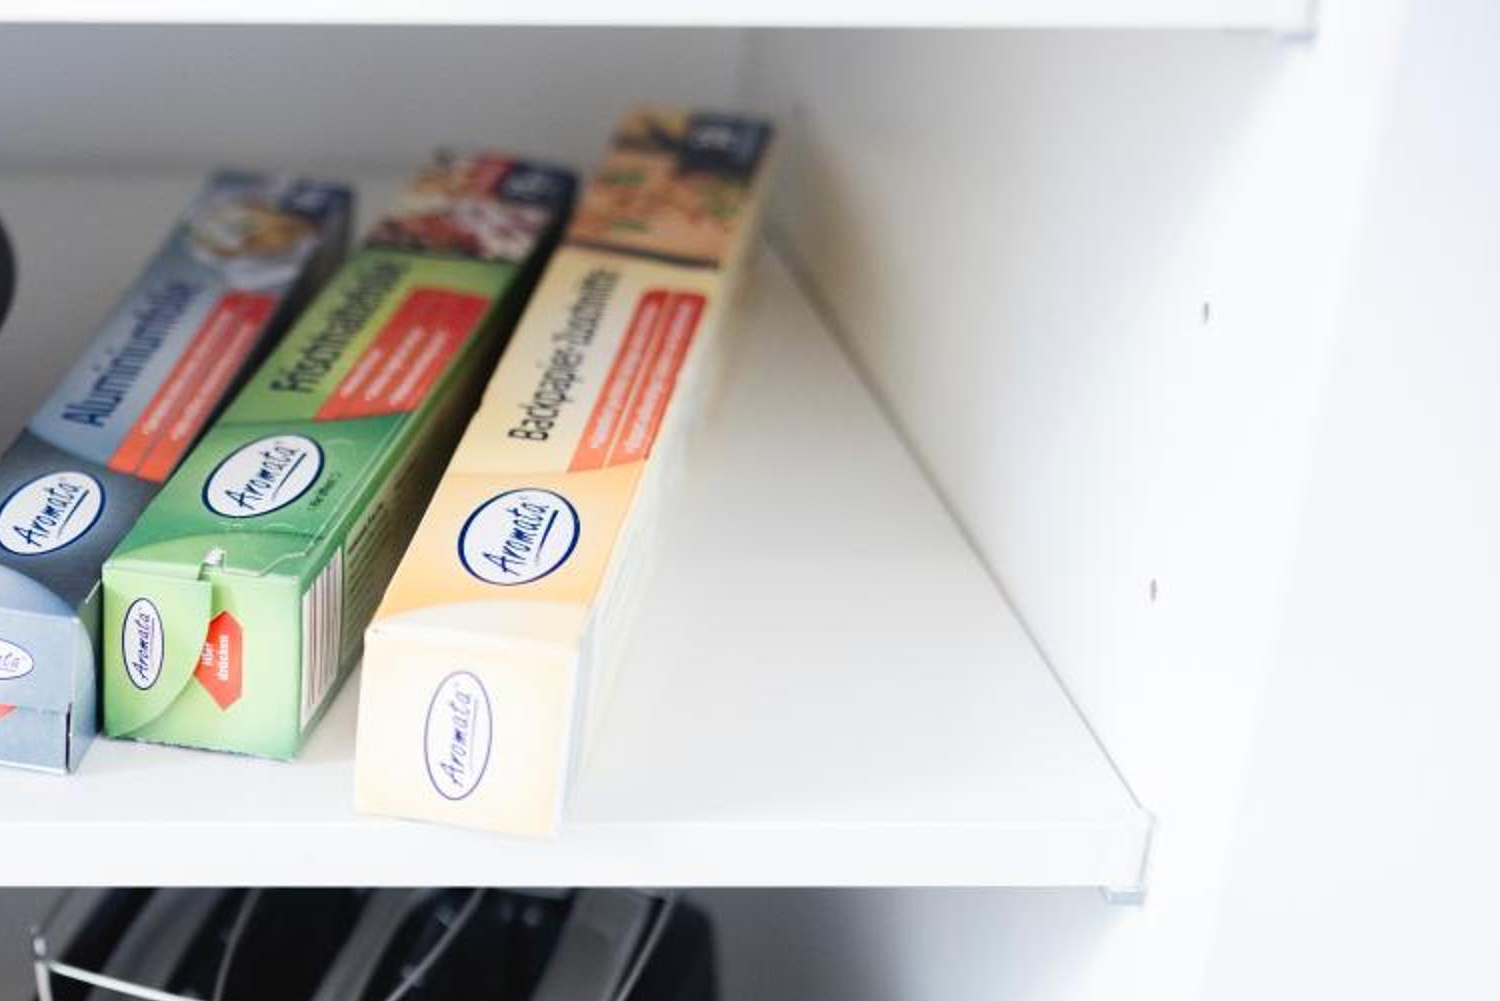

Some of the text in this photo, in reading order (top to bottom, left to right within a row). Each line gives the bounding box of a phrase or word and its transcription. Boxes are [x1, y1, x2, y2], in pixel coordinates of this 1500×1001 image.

[224, 445, 300, 511] Aromata
[13, 482, 80, 547] Aromata
[483, 502, 549, 576] Aromata
[131, 612, 150, 681] Aromata
[439, 690, 471, 788] Aromata
